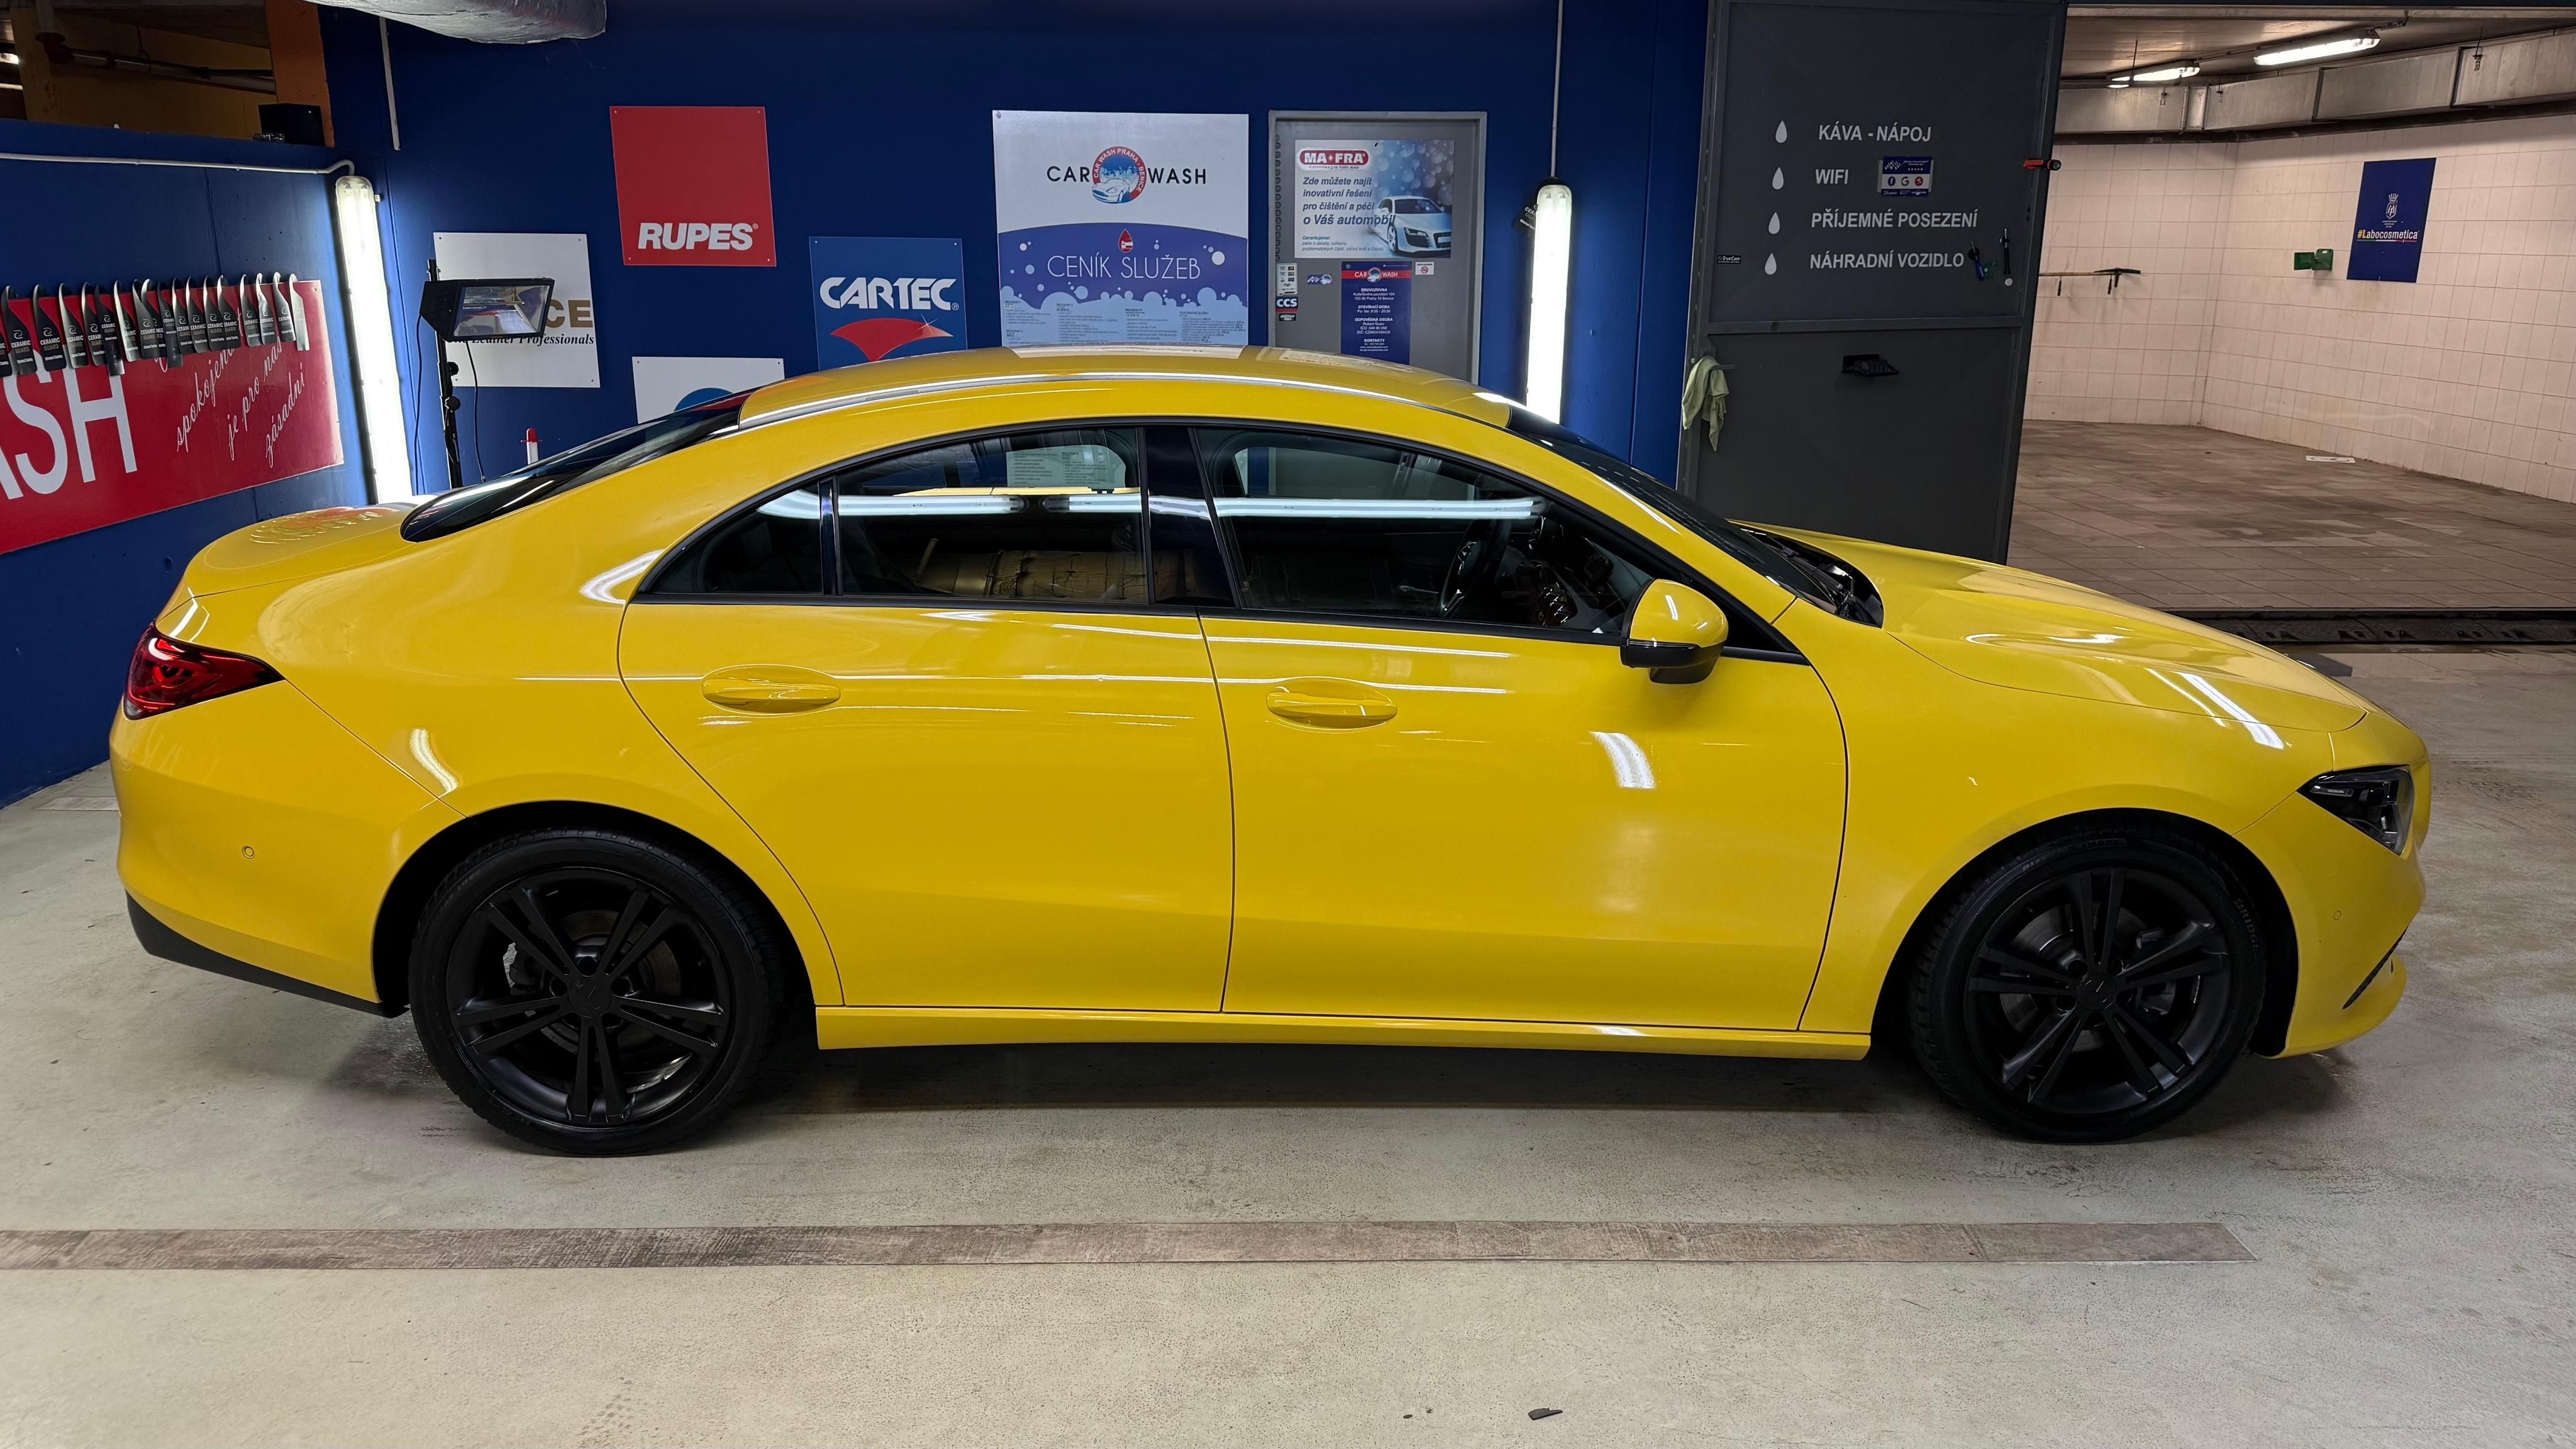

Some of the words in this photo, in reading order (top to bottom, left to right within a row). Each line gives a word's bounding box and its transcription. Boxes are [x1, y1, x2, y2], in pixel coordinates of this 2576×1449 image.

[1818, 121, 1862, 141] KÁVA
[1876, 122, 1931, 142] NÁPOJ
[1099, 148, 1116, 164] WASH
[1118, 148, 1138, 162] PRAHA
[1047, 165, 1090, 182] CAR
[1148, 168, 1206, 184] WASH
[1302, 177, 1319, 185] Zde
[1321, 177, 1352, 185] můžete
[1353, 177, 1372, 187] najít
[1815, 169, 1849, 184] WIFI
[1303, 189, 1343, 197] inovativní
[1346, 189, 1373, 197] řešení
[1302, 203, 1317, 212] pro
[1319, 202, 1348, 210] čištění
[1303, 217, 1311, 225] o
[1314, 214, 1334, 225] Váš
[1337, 214, 1396, 226] automobil
[1811, 208, 1894, 228] PŘÍJEMNÉ
[1898, 208, 1979, 228] POSEZENÍ
[2357, 230, 2418, 240] #Labocosmetica
[1047, 252, 1112, 278] CENÍK
[1121, 254, 1201, 279] SLUŽEB
[1810, 250, 1894, 269] NÁHRADNÍ
[1897, 253, 1964, 268] VOZIDLO
[1276, 298, 1297, 308] CCS
[228, 414, 239, 461] je
[242, 377, 260, 432] pro
